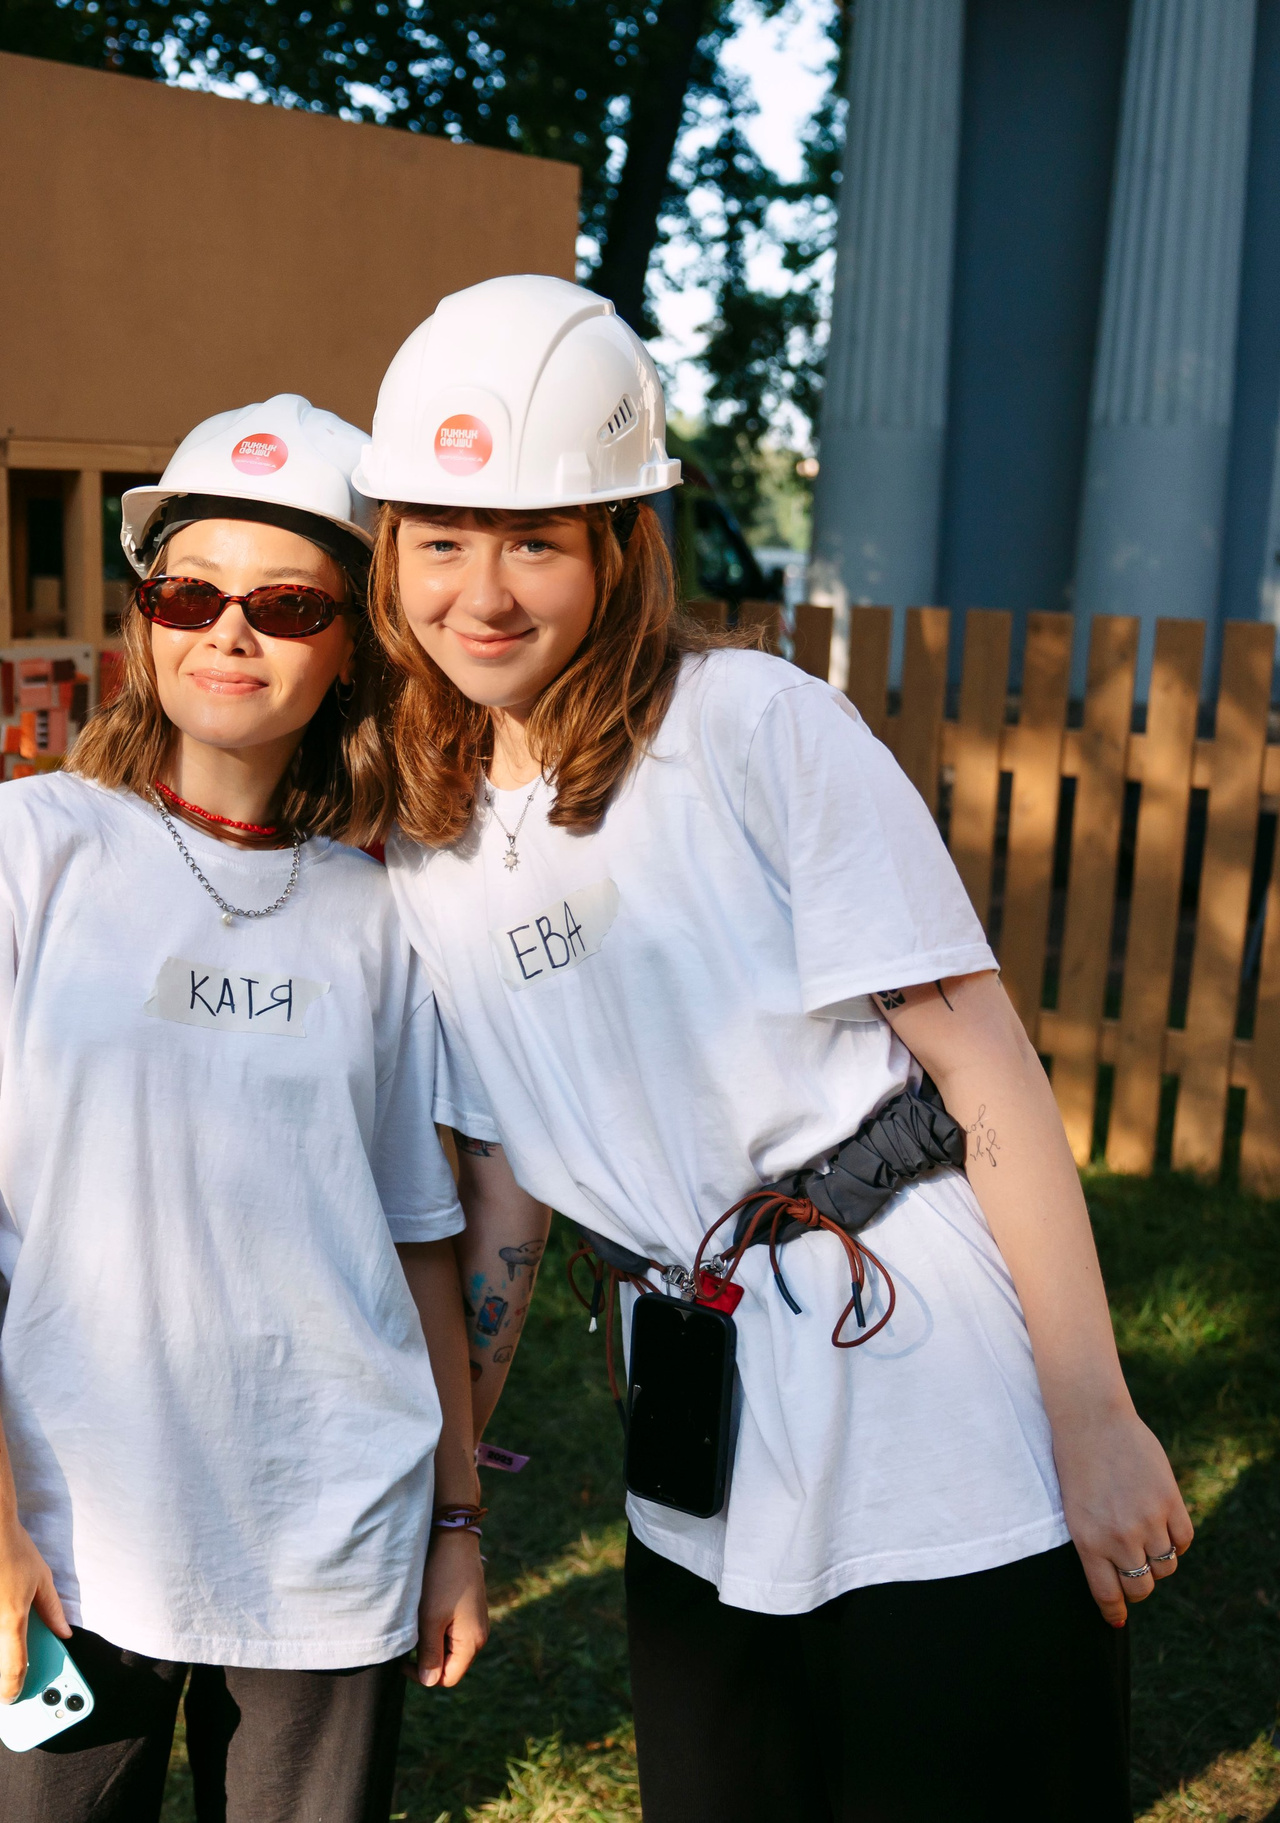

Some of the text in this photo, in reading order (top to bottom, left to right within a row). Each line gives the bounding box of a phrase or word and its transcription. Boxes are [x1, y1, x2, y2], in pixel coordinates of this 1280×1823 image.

[506, 900, 585, 980] ЕВА
[189, 970, 294, 1021] КАТЯ
[487, 1450, 513, 1466] 2025
